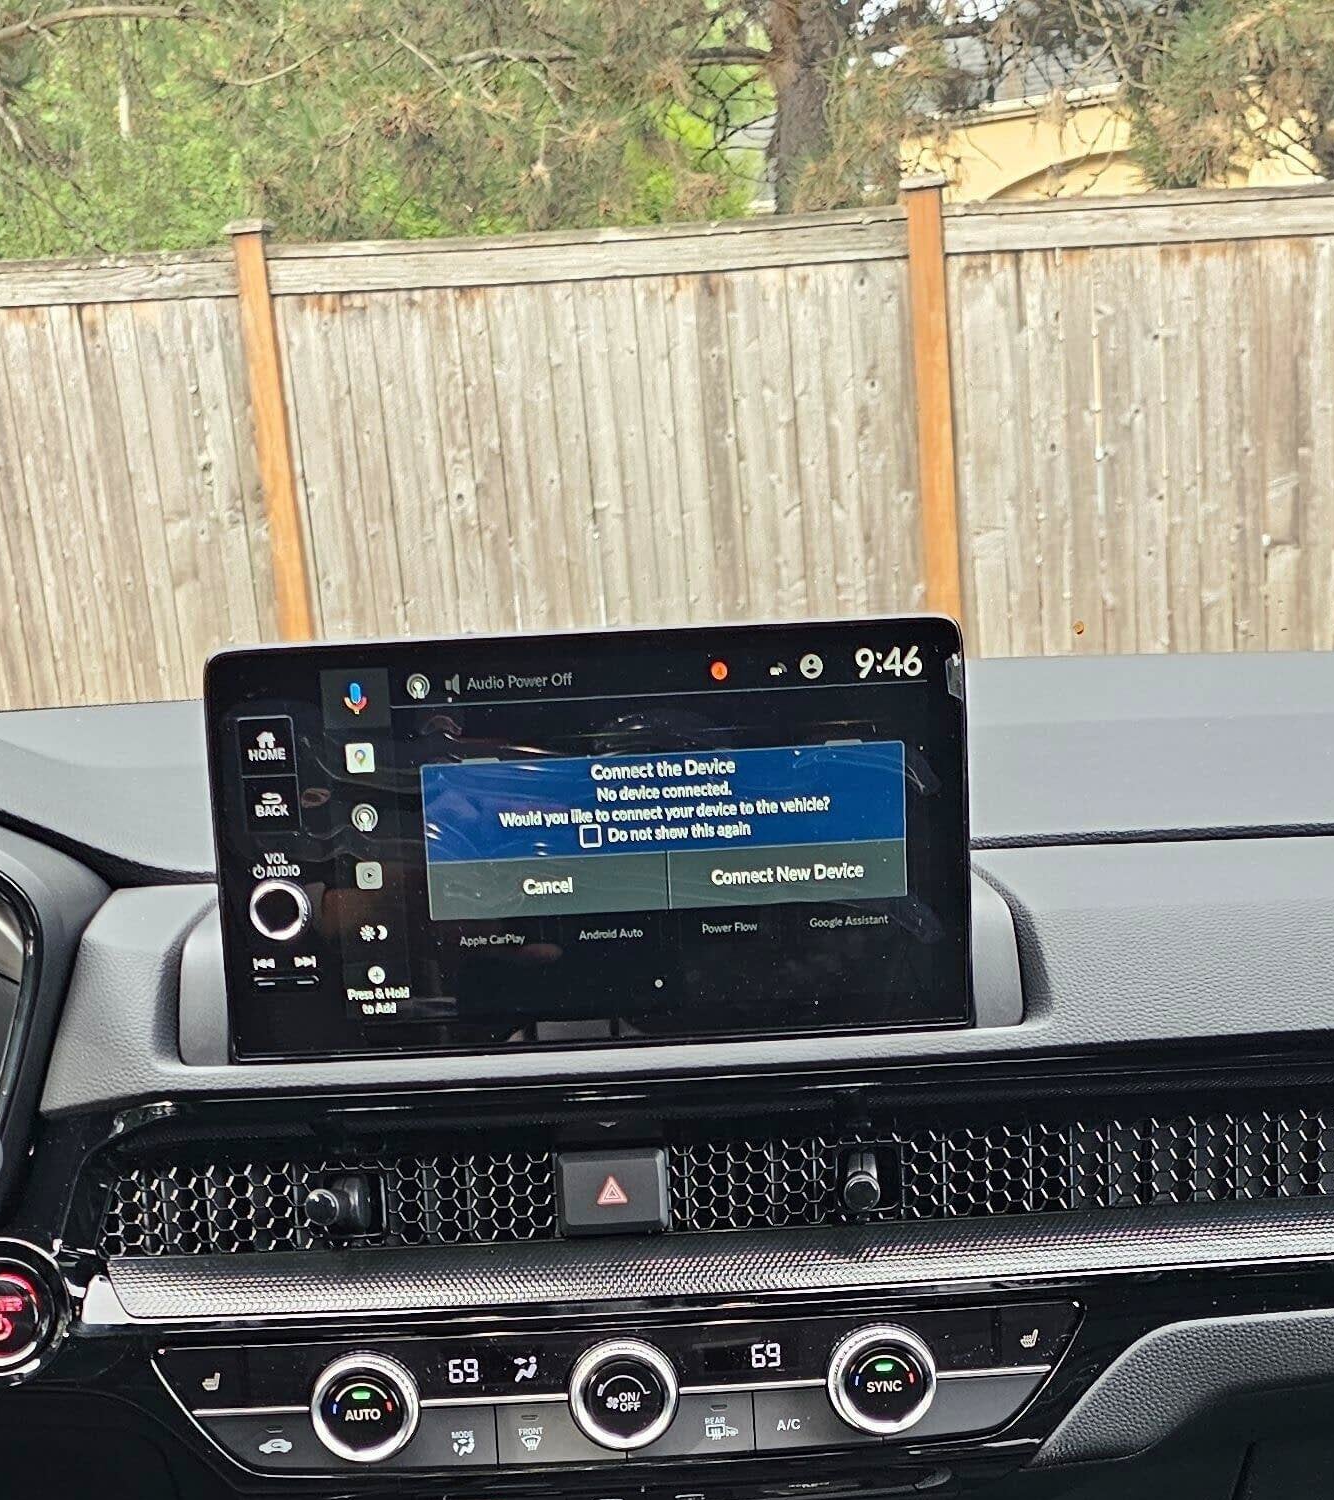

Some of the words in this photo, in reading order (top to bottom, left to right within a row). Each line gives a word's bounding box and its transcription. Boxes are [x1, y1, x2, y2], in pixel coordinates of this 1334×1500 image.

[855, 646, 923, 679] 9:46
[467, 676, 505, 691] Audio
[508, 674, 548, 689] Power
[551, 672, 573, 687] Off
[248, 746, 286, 762] HOME
[590, 762, 654, 781] Connect
[656, 760, 682, 778] the
[684, 758, 736, 777] Device
[596, 787, 617, 803] No
[619, 785, 660, 801] device
[662, 780, 733, 799] connected.
[255, 802, 289, 819] BACK
[498, 811, 543, 828] Would
[543, 813, 569, 828] you
[570, 808, 593, 824] like
[594, 808, 610, 823] to
[611, 806, 663, 822] connect
[664, 805, 694, 822] your
[696, 802, 737, 818] device
[739, 801, 755, 815] to
[756, 798, 779, 815] the
[780, 795, 831, 813] vehicle?
[607, 827, 628, 843] Do
[630, 826, 653, 841] not
[655, 825, 688, 841] show
[691, 822, 715, 838] this
[716, 821, 752, 839] again
[264, 852, 289, 866] VOL
[266, 864, 301, 879] AUDIO
[711, 867, 774, 886] Connect
[776, 865, 812, 882] New
[814, 862, 864, 880] Device
[523, 877, 574, 895] Cancel
[701, 923, 733, 935] Power
[734, 921, 758, 932] Flow
[809, 917, 843, 929] Google
[844, 914, 889, 927] Assistant
[459, 935, 487, 948] Apple
[489, 934, 526, 946] CarPlay
[578, 928, 617, 940] Android
[619, 928, 644, 939] Auto
[347, 989, 374, 1001] Press
[375, 987, 385, 999] &
[385, 986, 410, 999] Hold
[362, 1003, 374, 1015] to
[375, 1002, 397, 1014] Add
[750, 1342, 782, 1369] 69
[448, 1358, 480, 1384] 69
[866, 1380, 903, 1394] SYNC
[619, 1391, 641, 1403] ON/
[619, 1401, 641, 1413] OFF
[344, 1408, 381, 1422] AUTO
[704, 1416, 726, 1426] REAR
[518, 1426, 544, 1437] FRONT
[776, 1418, 801, 1432] A/C
[451, 1430, 474, 1440] MODE
